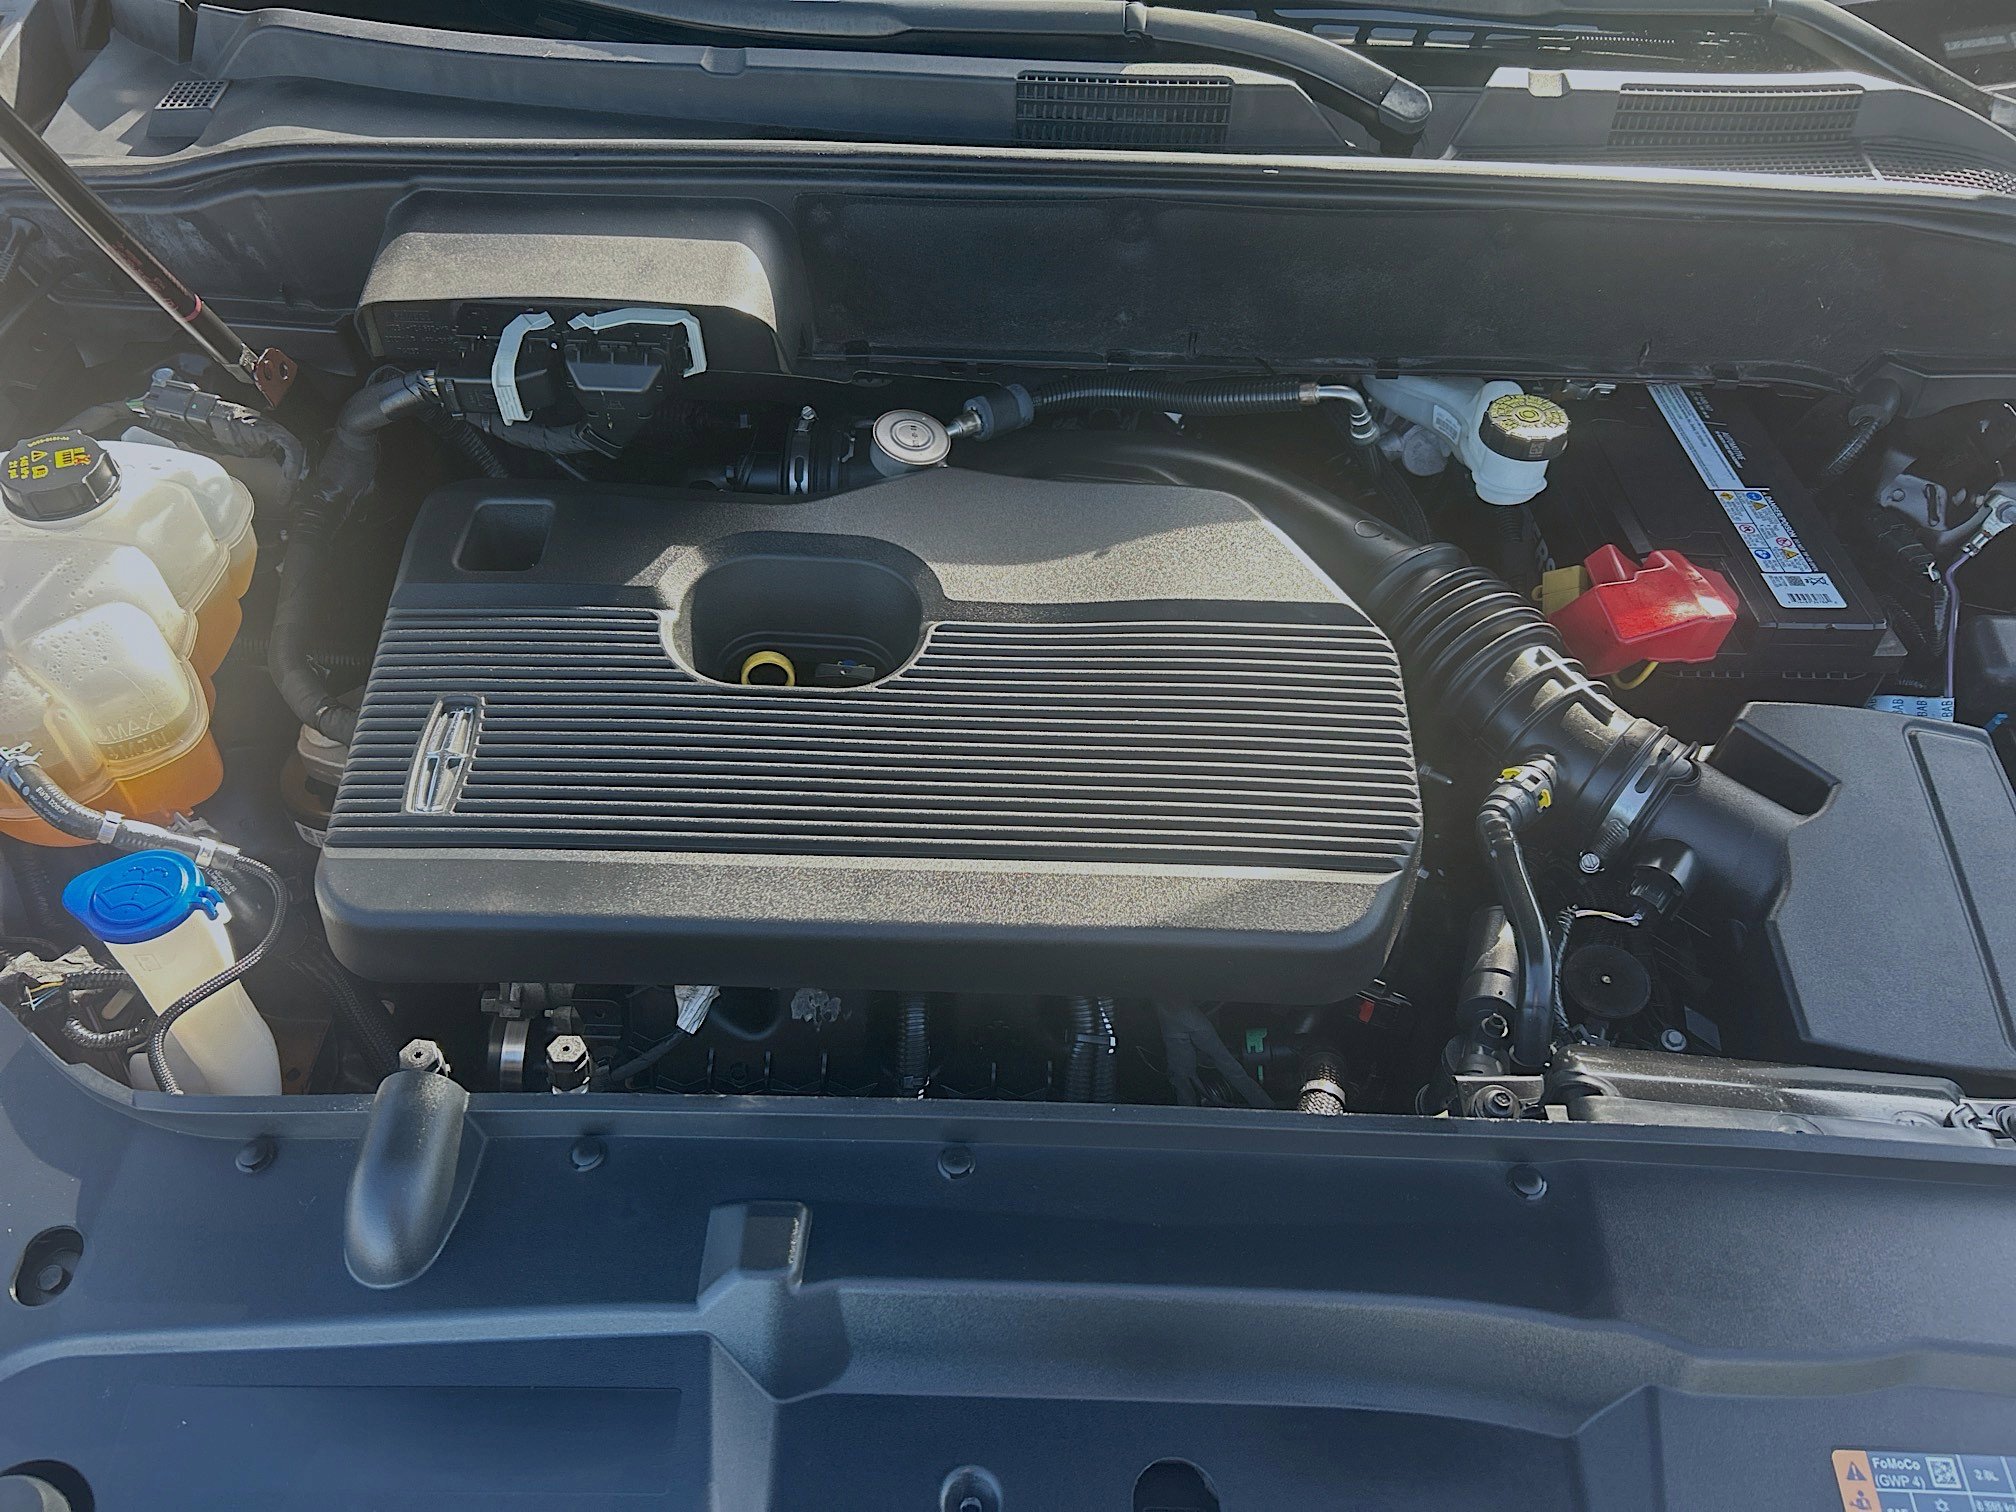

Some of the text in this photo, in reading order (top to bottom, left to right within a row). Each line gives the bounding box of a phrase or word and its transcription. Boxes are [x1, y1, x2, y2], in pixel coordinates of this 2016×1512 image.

[1916, 700, 1928, 717] BAB
[1941, 700, 1953, 718] BAB
[1872, 1457, 1921, 1471] FoMoCo
[1875, 1474, 1909, 1488] (GWP
